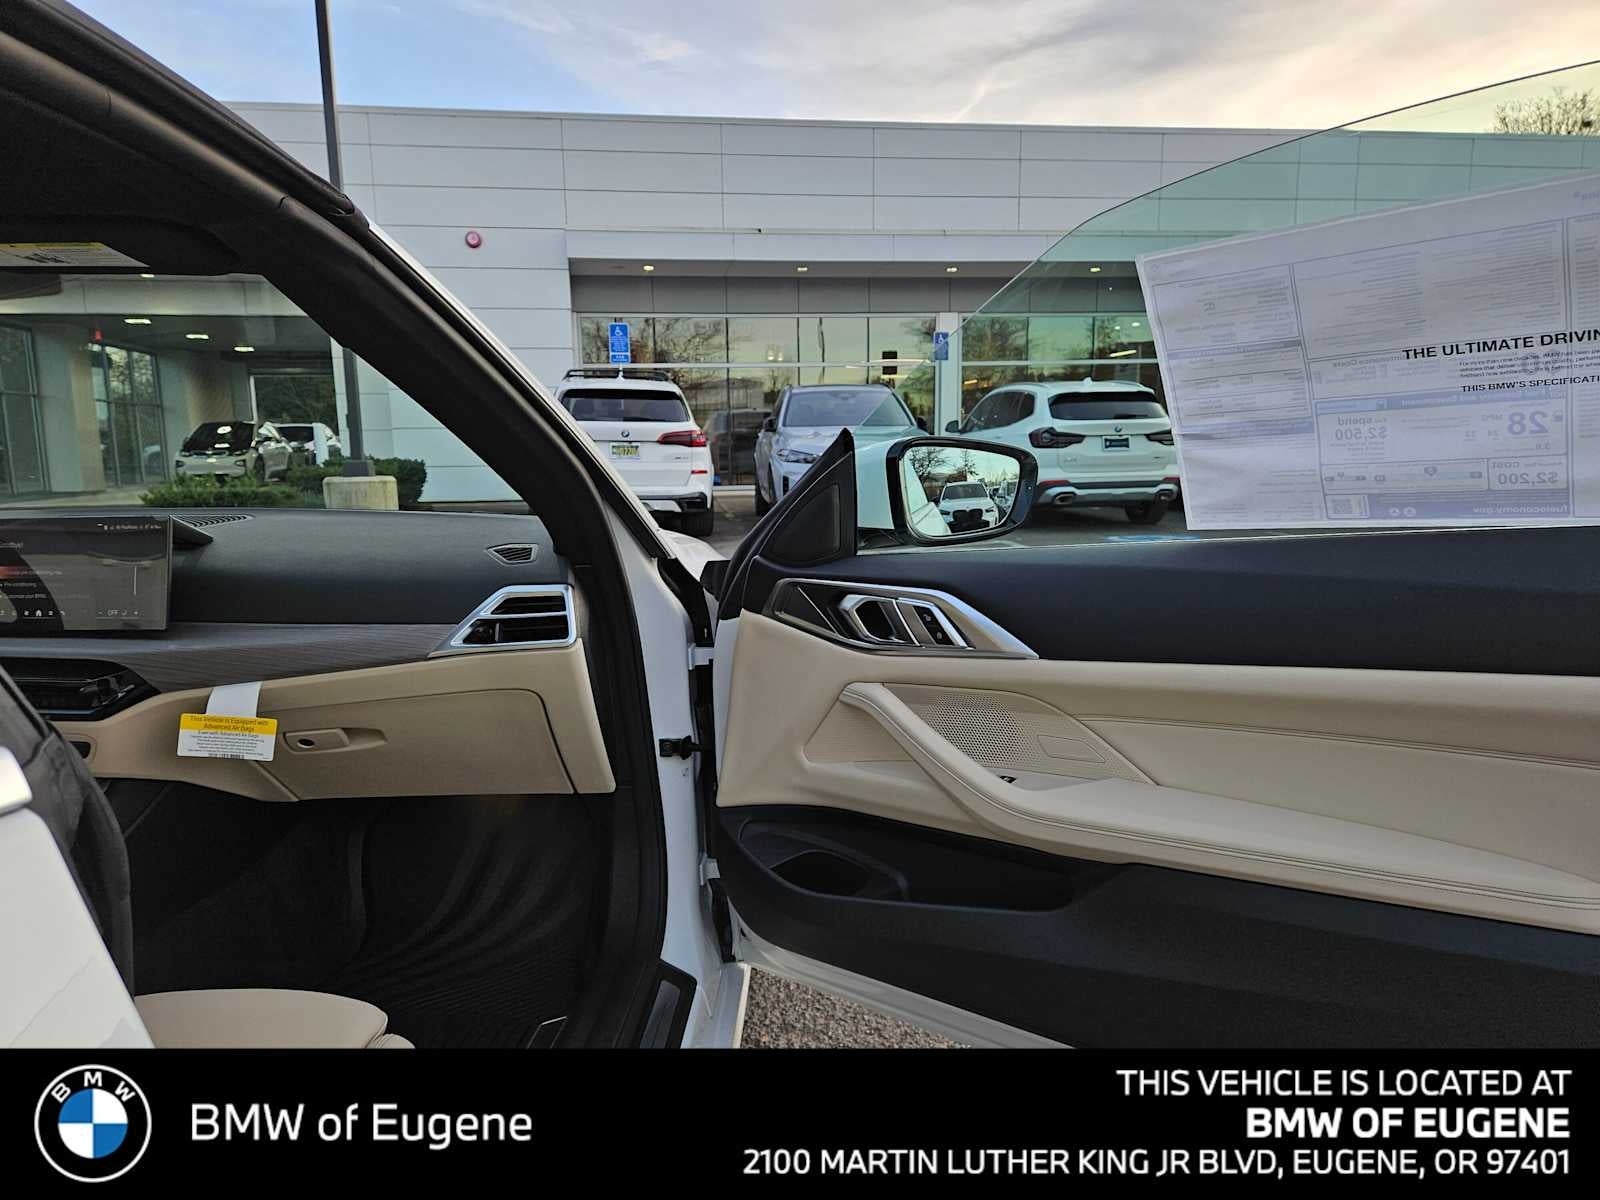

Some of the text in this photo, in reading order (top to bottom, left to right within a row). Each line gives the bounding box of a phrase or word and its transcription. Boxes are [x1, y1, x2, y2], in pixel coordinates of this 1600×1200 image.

[1402, 346, 1438, 361] THE
[1442, 336, 1535, 356] ULTIMATE
[1461, 384, 1486, 392] THIS
[1488, 381, 1527, 390] BMW'S
